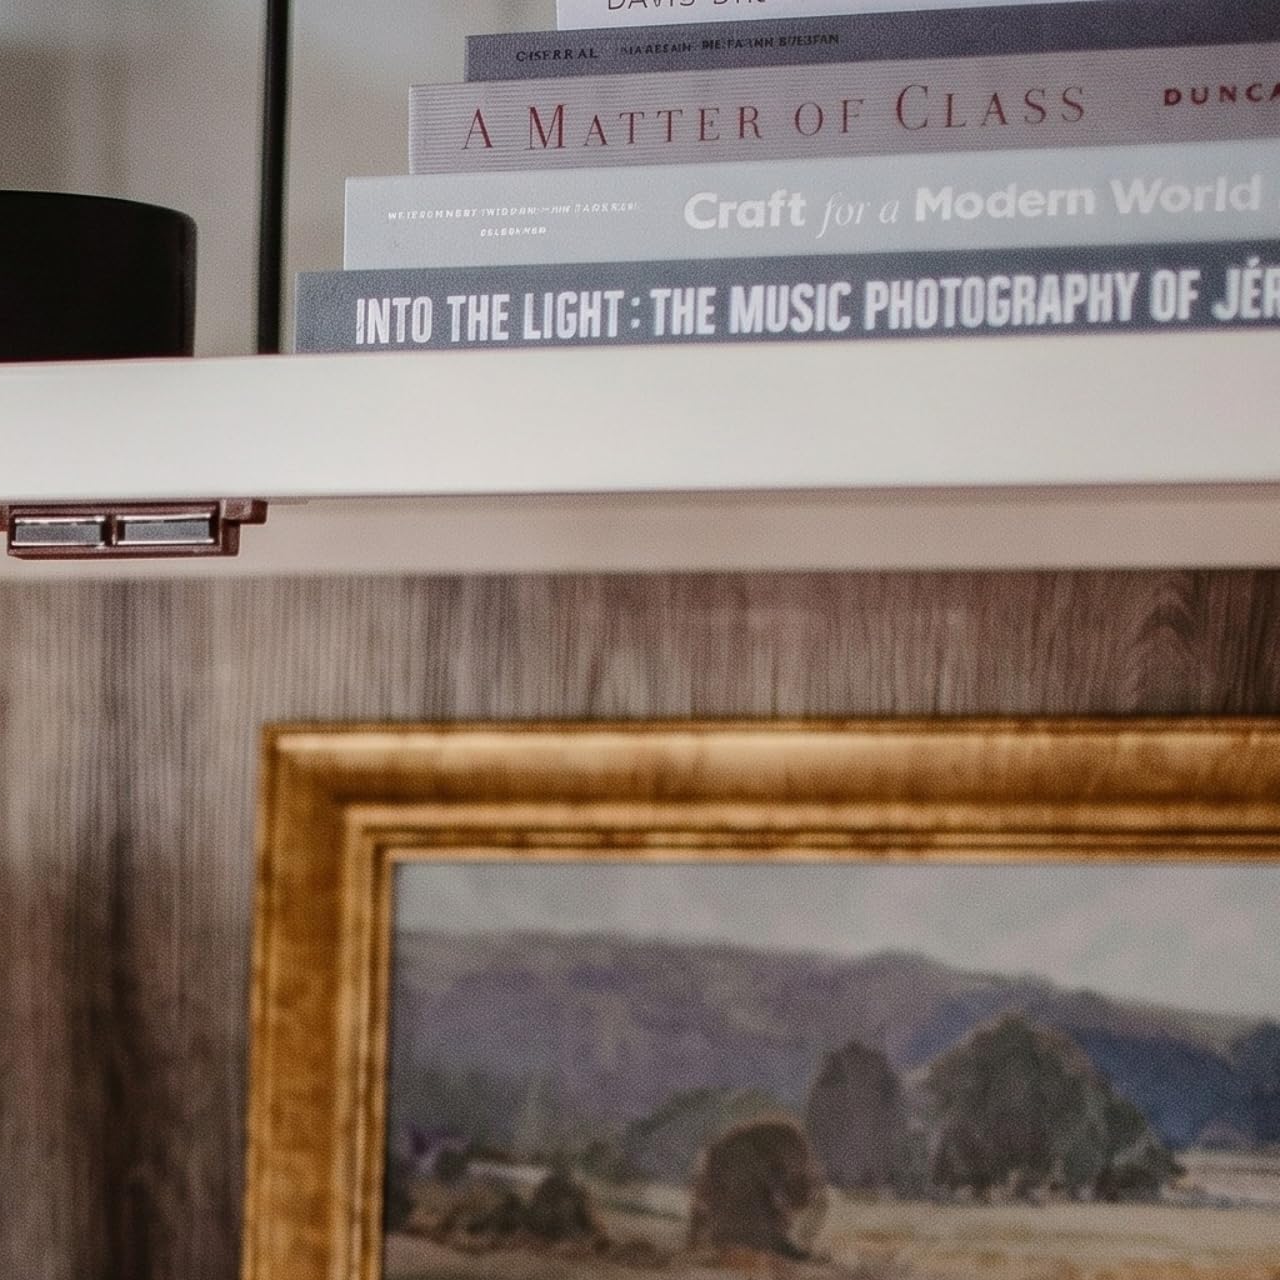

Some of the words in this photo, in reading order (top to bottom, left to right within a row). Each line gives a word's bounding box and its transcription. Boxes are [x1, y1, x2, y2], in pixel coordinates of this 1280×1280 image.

[461, 108, 493, 150] A
[524, 103, 763, 150] MATTER
[793, 99, 865, 136] OF
[896, 84, 1085, 130] CLASS
[684, 190, 806, 230] Craft
[816, 192, 871, 239] for
[879, 205, 898, 224] a
[915, 182, 1095, 221] Modern
[1109, 174, 1262, 214] World
[356, 296, 433, 345] INTO
[447, 293, 510, 341] THE
[649, 287, 716, 336] THE
[729, 281, 851, 335] MUSIC
[864, 271, 1139, 330] PHOTOGRAPHY
[1150, 268, 1201, 322] OF
